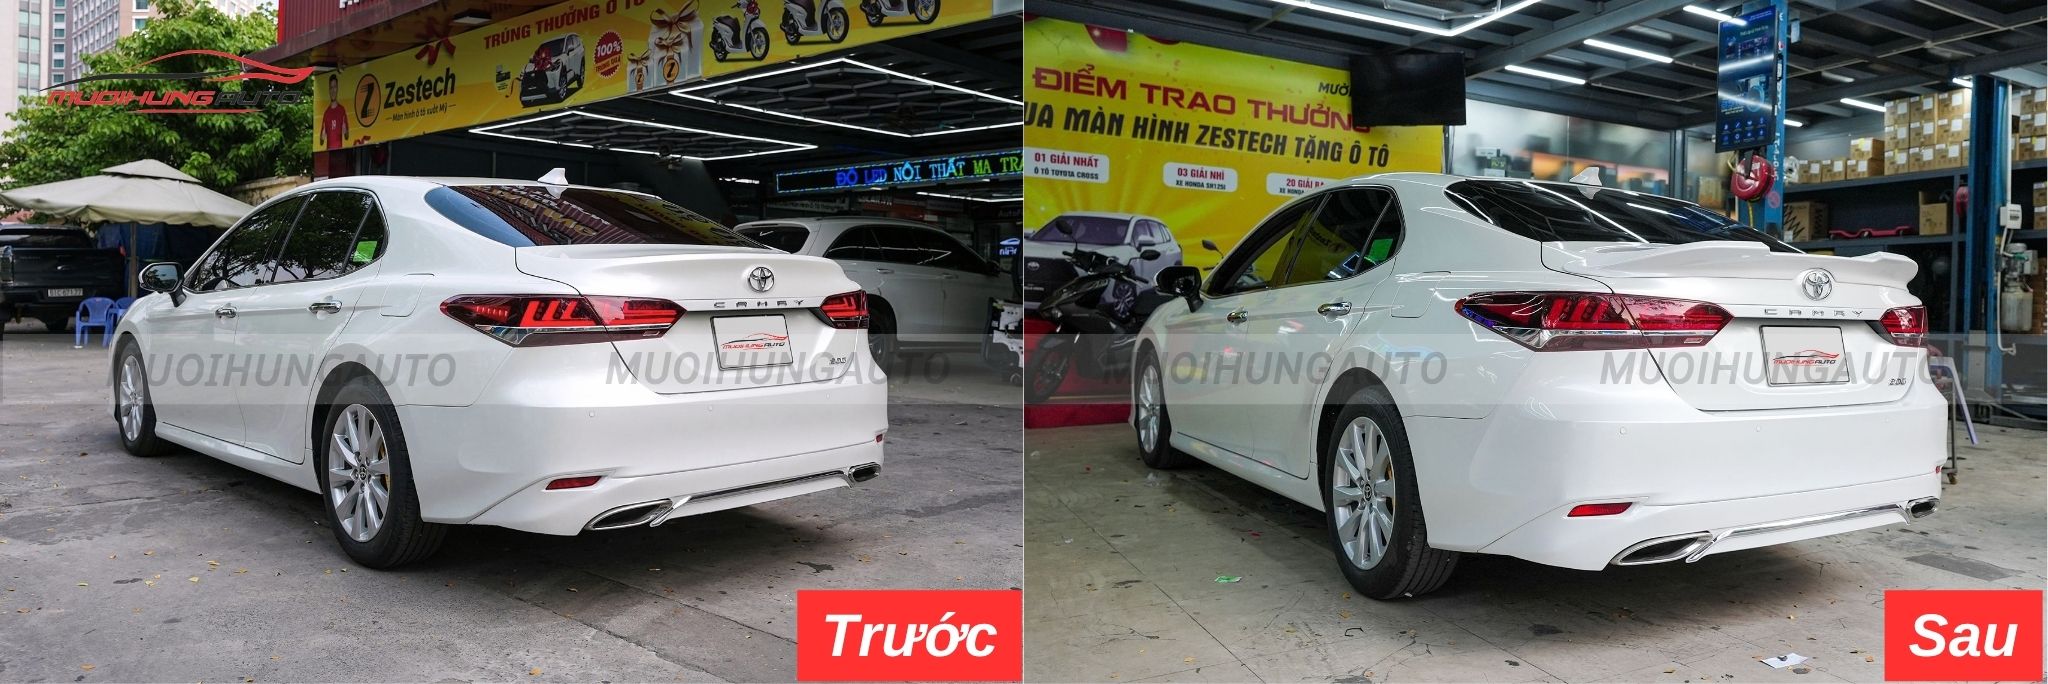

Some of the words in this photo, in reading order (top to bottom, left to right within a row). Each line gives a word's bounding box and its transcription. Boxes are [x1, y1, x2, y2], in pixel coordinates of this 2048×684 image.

[484, 27, 531, 49] TRÚNG
[597, 41, 621, 57] 100%
[384, 67, 456, 109] Zestech
[1032, 64, 1127, 100] ĐIỂM
[1140, 83, 1236, 115] TRAO
[1063, 106, 1125, 137] MÀN
[1131, 113, 1190, 144] HÌNH
[1194, 124, 1288, 156] ZESTECH
[1295, 134, 1343, 164] TẶNG
[1348, 140, 1362, 164] Ô
[1368, 144, 1390, 168] TÔ
[1034, 153, 1046, 162] 01
[1050, 152, 1070, 165] GIẢI
[1073, 155, 1099, 168] NHẤT
[864, 169, 887, 183] LED
[972, 159, 992, 175] MA
[1051, 169, 1075, 177] TOYOTA
[1076, 171, 1098, 180] CROSS
[1177, 167, 1188, 176] 03
[1191, 167, 1207, 179] GIẢI
[1185, 180, 1204, 188] HONDA
[1286, 178, 1296, 187] 20
[714, 300, 804, 308] CAMRY
[1764, 308, 1863, 318] CAMRY
